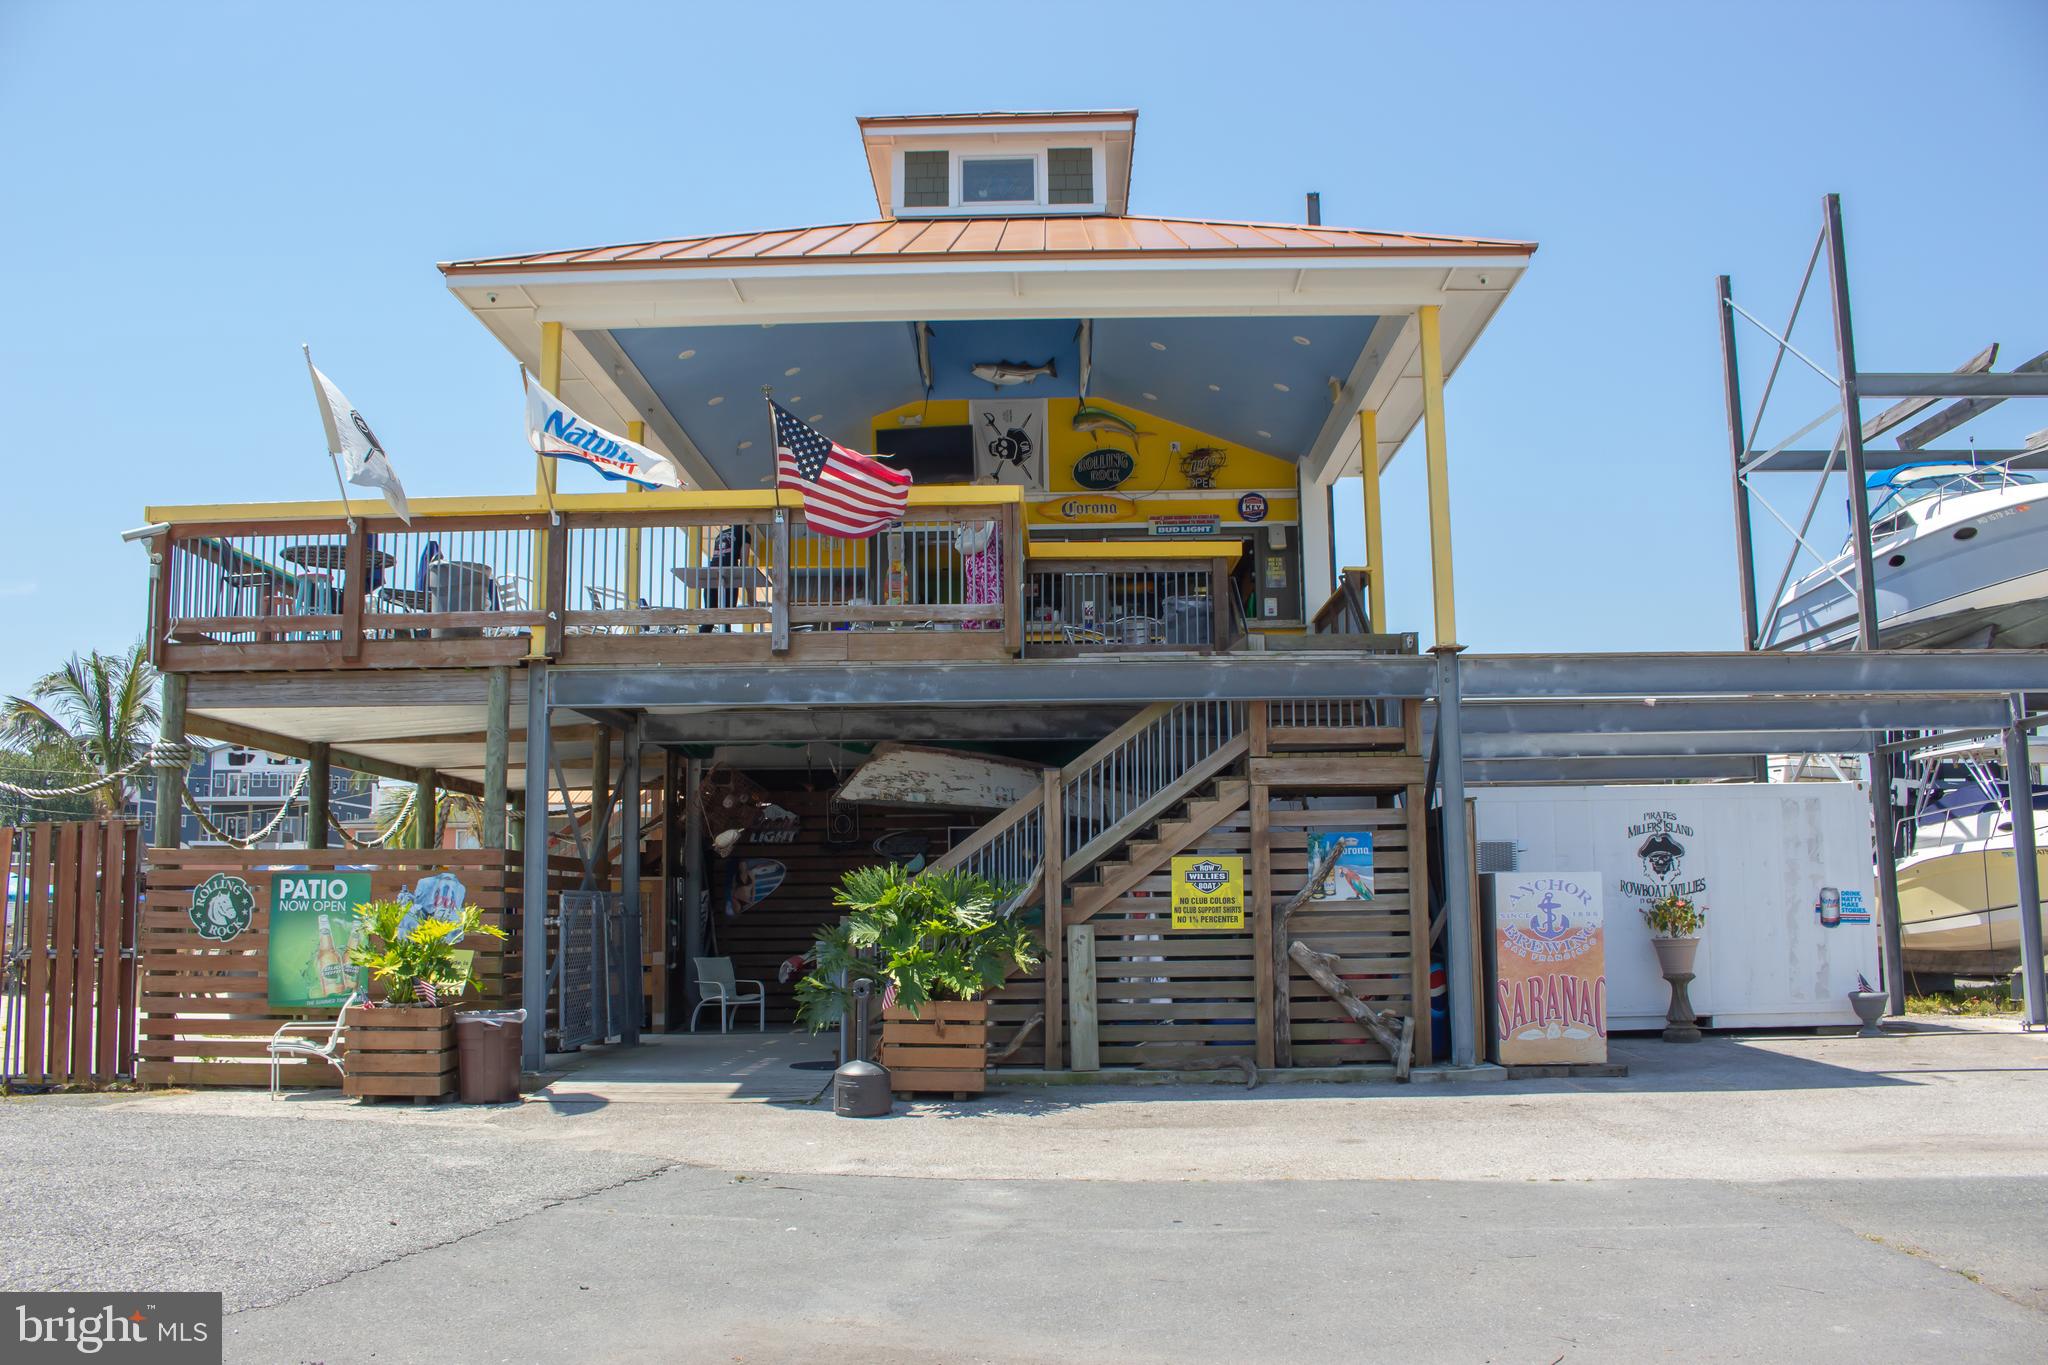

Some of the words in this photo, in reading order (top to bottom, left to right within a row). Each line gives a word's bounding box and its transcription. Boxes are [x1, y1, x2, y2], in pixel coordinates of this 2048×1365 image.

[1078, 453, 1129, 473] ROLLING
[1090, 468, 1120, 482] ROCK
[1061, 501, 1118, 518] Corona
[1181, 525, 1211, 533] LIGHT
[1643, 811, 1677, 821] PIRATES
[750, 831, 796, 842] LIGHT
[1663, 821, 1694, 837] ISLAND
[1342, 847, 1369, 855] orona
[196, 880, 244, 907] ROLLING
[280, 879, 348, 900] PATIO
[1509, 879, 1592, 908] ANCHOR
[1620, 880, 1668, 898] ROWBOAT
[1670, 878, 1706, 897] WILLIES
[279, 900, 310, 912] NOW
[313, 900, 346, 912] OPEN
[1179, 897, 1189, 905] NO
[208, 918, 245, 937] ROCK
[1503, 921, 1597, 954] BREWING
[1496, 974, 1606, 1041] SARANAC
